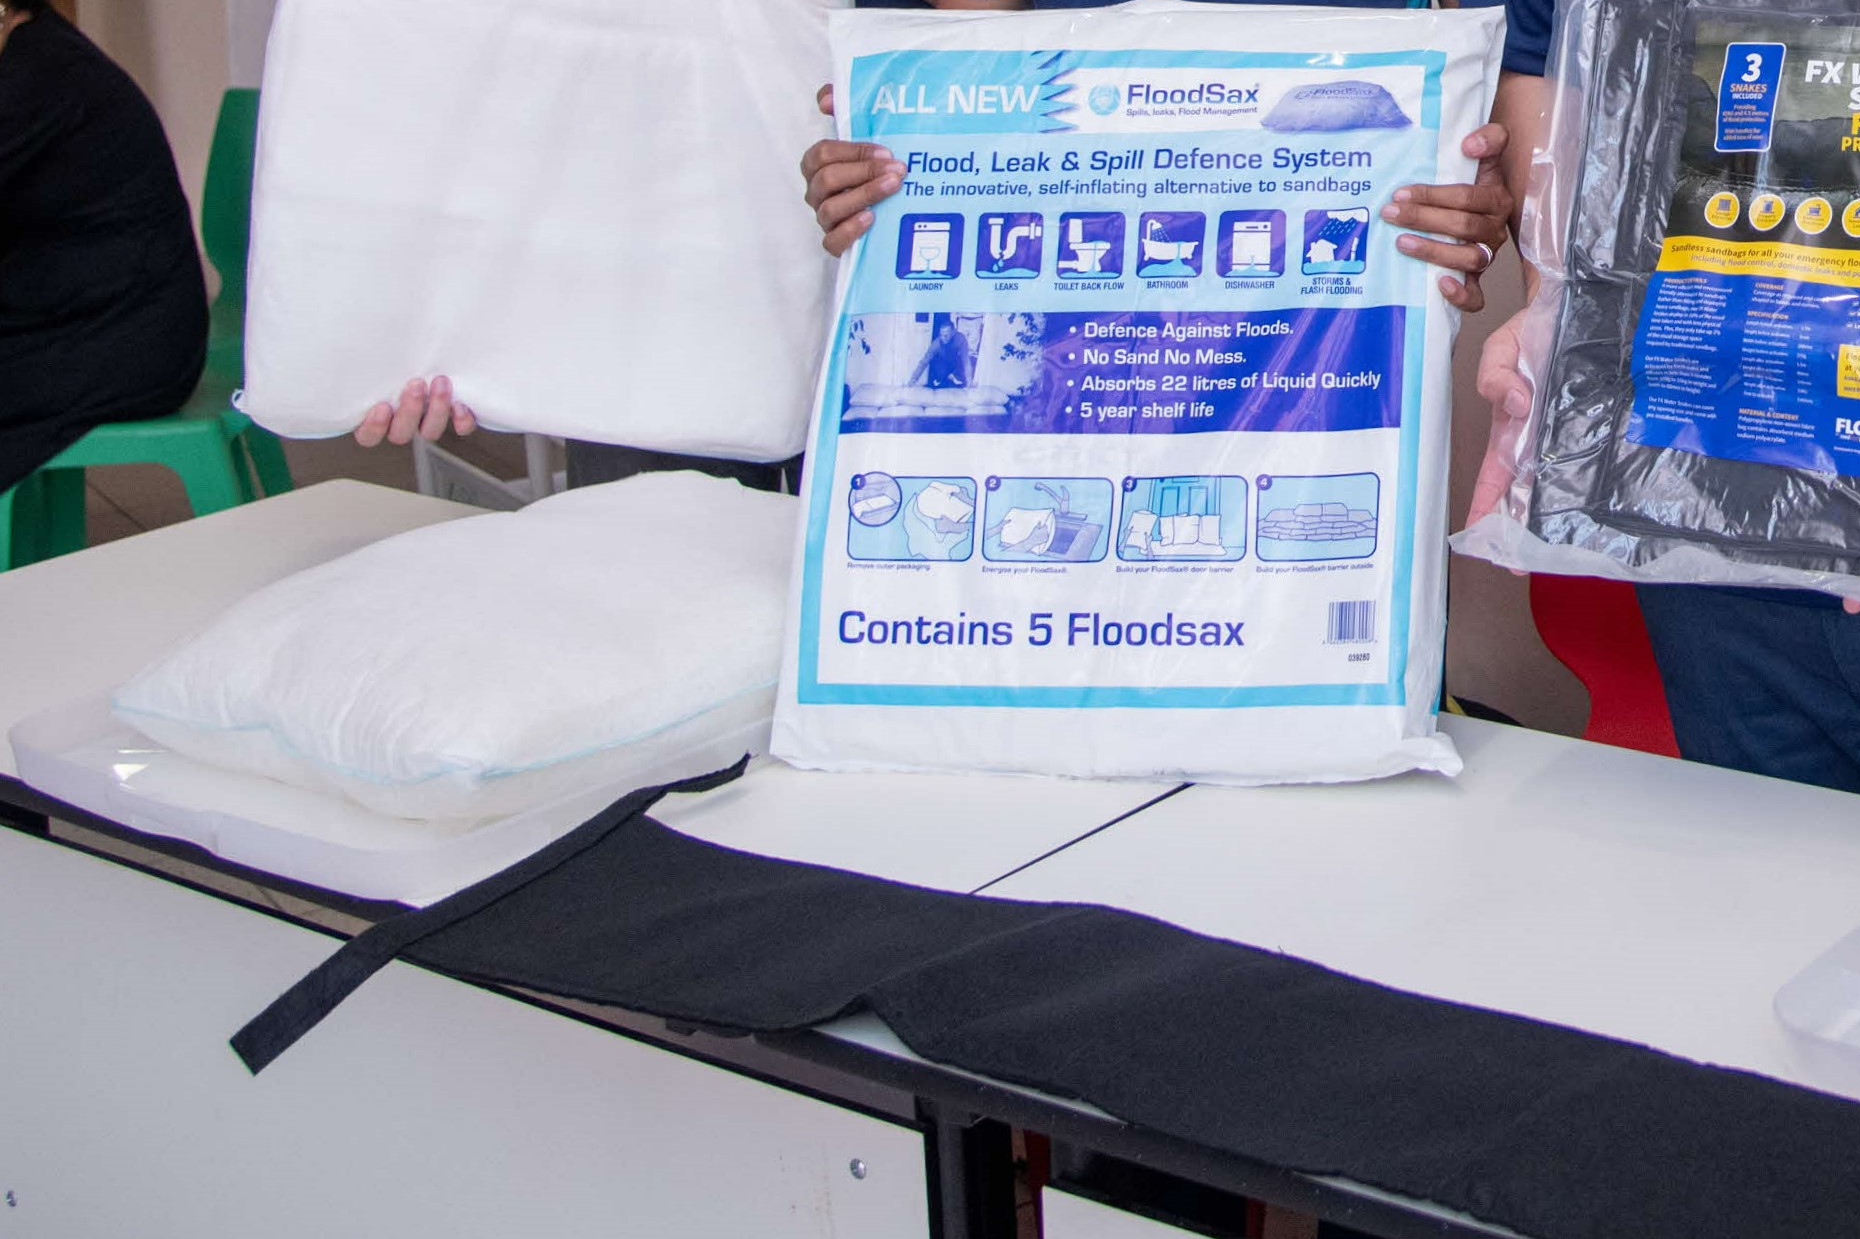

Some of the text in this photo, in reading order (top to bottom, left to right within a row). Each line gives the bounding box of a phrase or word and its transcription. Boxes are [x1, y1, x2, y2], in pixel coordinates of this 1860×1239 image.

[1741, 53, 1763, 82] 3
[1804, 60, 1845, 84] FX
[1730, 83, 1768, 93] SNAKES
[871, 84, 1040, 114] ALL NEW
[1126, 106, 1258, 117] Spills, leaks, Flood Management
[907, 147, 1372, 176] Flood, Leak & Spill Defence System
[904, 177, 1371, 198] The innovative, self-inflating alternative to sandbags
[1671, 244, 1704, 253] Sandless
[1706, 245, 1746, 258] sandbags
[1761, 249, 1772, 257] all
[1774, 251, 1793, 260] your
[1797, 255, 1846, 267] emergency
[1728, 258, 1746, 266] flood
[1747, 259, 1776, 268] control,
[1814, 266, 1835, 276] leaks
[1837, 269, 1851, 277] and
[995, 282, 1019, 291] LEAKS
[1054, 282, 1125, 291] TOILET BACK FLOW
[1147, 280, 1189, 289] BATHROOM
[1225, 280, 1275, 289] DISHWASHER
[1312, 277, 1351, 286] STORMS &
[909, 283, 943, 291] LAUNDRY
[1300, 286, 1363, 295] FLASH FLOODING
[1084, 320, 1294, 342] Defence Against Floods.
[1083, 349, 1247, 364] No Sand No Mess.
[1081, 371, 1381, 392] Absorbs 22 litres of Liquid Quickly
[1080, 402, 1215, 422] 5 year shelf life
[854, 477, 861, 486] 1
[989, 479, 997, 488] 2
[1125, 479, 1133, 489] 3
[1260, 478, 1268, 487] 4
[1327, 563, 1350, 571] barrier
[1351, 562, 1374, 570] outside
[839, 610, 1245, 646] Contains 5 Floodsax
